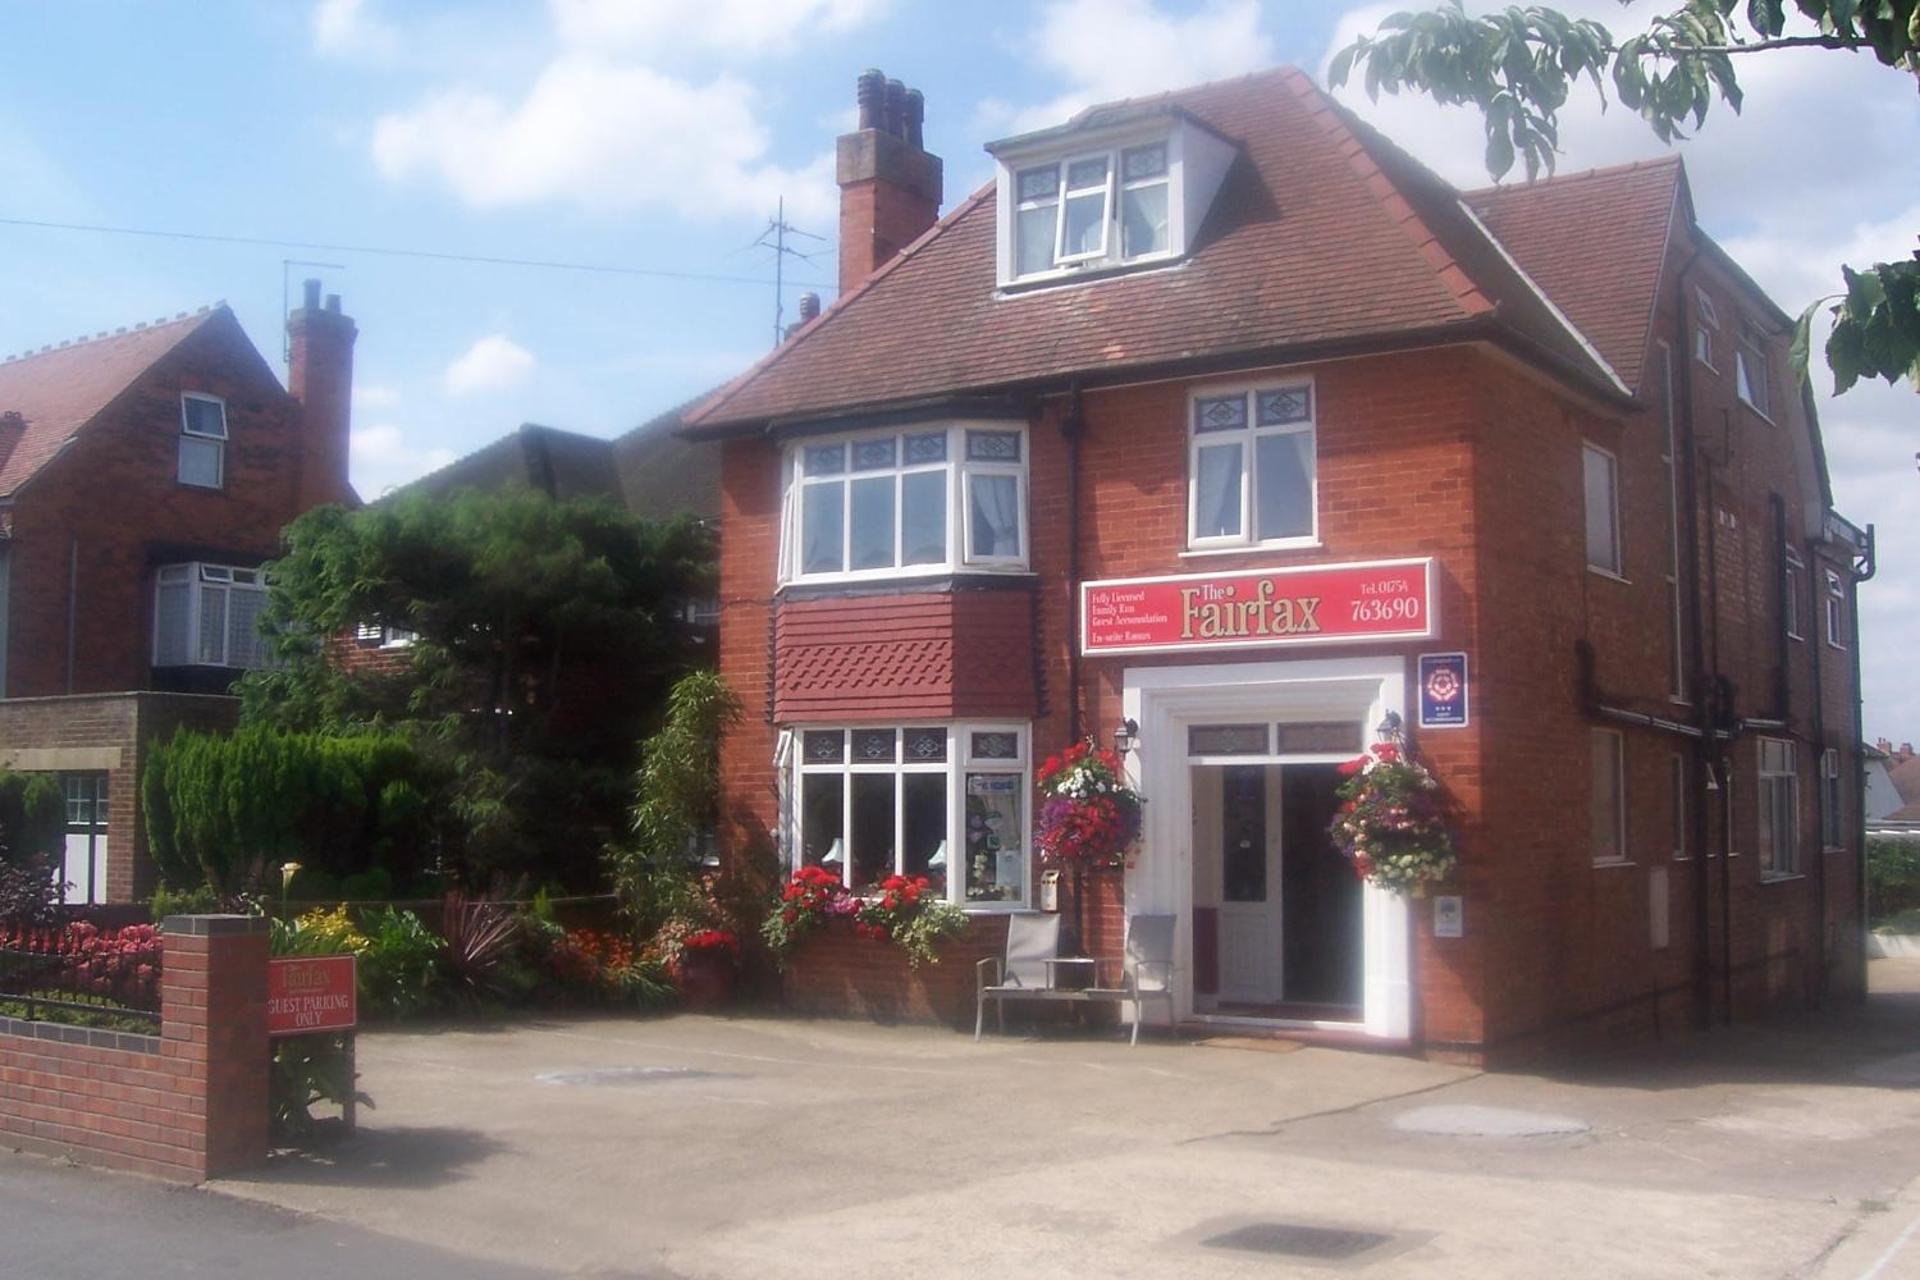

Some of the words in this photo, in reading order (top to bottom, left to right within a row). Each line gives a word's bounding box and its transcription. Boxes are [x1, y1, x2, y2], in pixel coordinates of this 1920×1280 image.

[1200, 583, 1225, 600] The
[1180, 579, 1320, 638] Fairfax
[1351, 597, 1419, 621] 763690
[268, 997, 301, 1014] GUEST
[303, 994, 349, 1011] PARKING
[296, 1011, 323, 1026] ONLY
